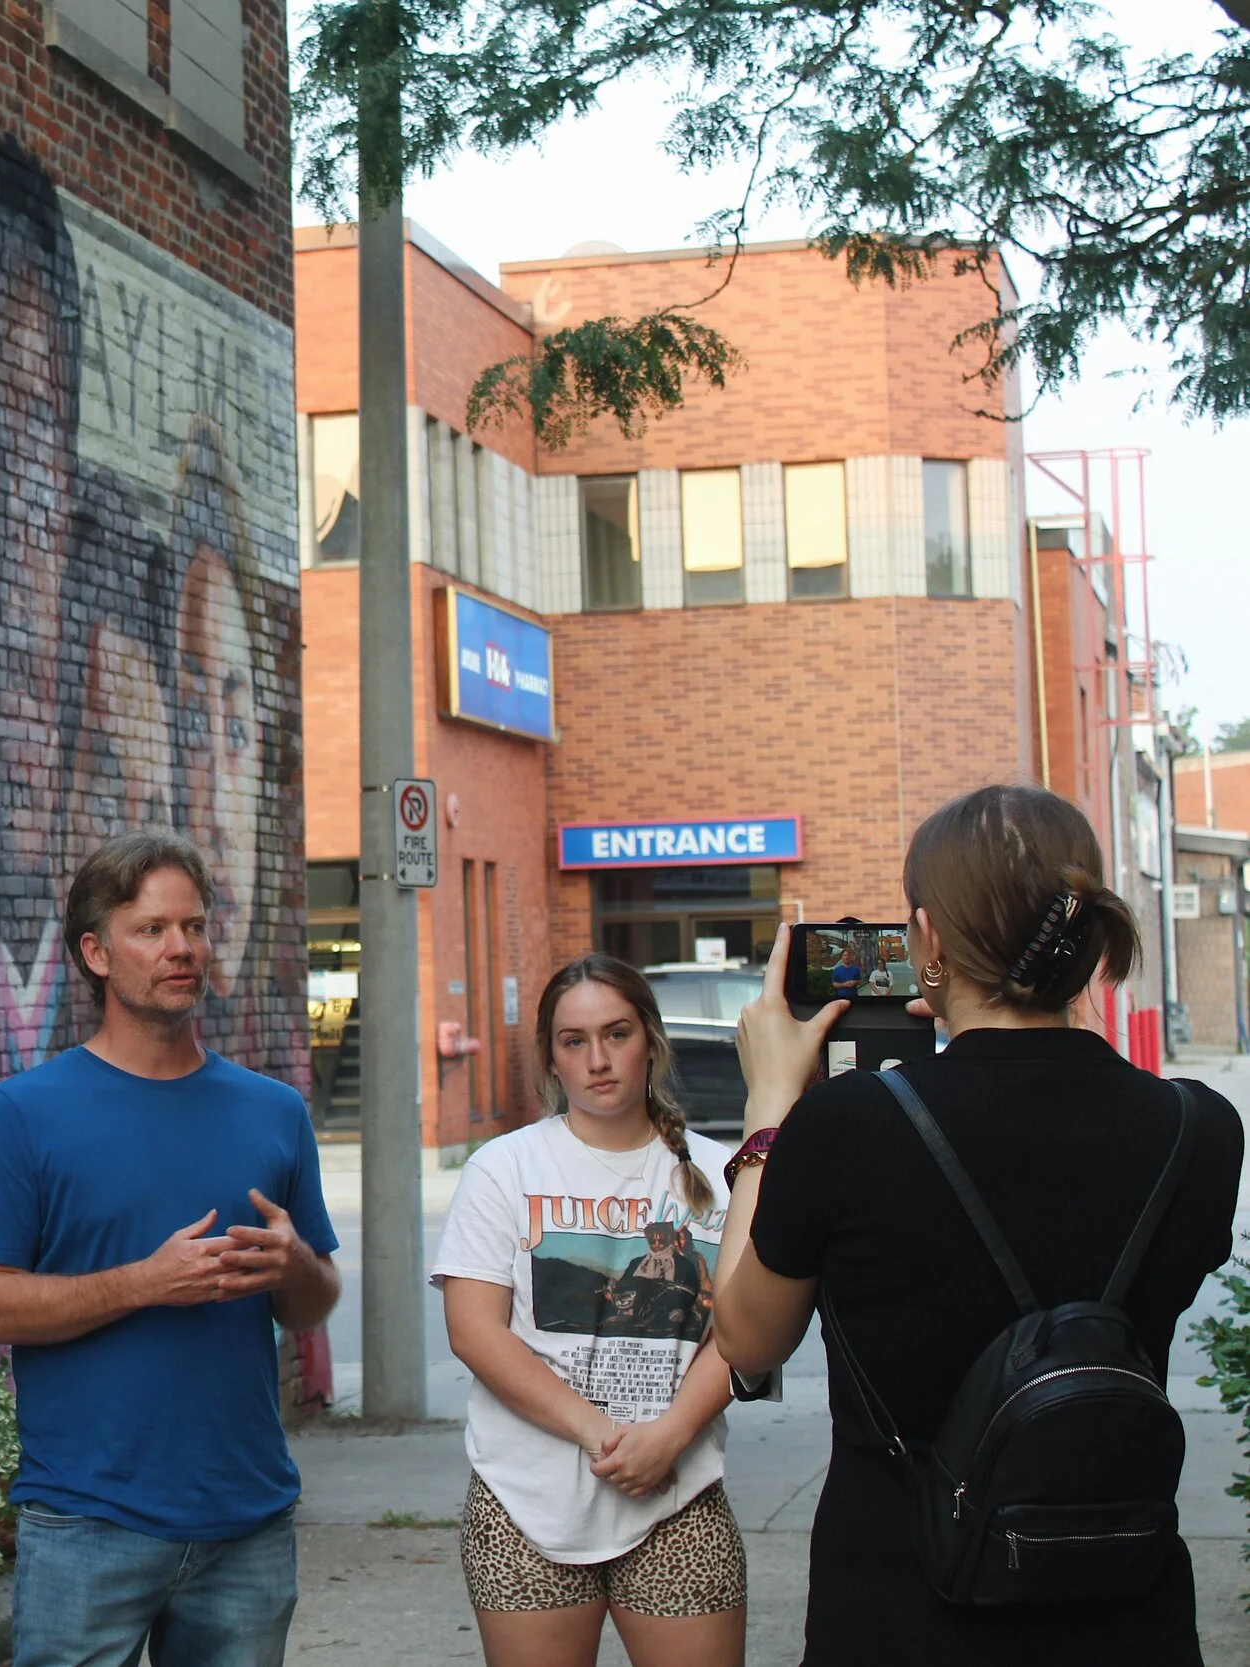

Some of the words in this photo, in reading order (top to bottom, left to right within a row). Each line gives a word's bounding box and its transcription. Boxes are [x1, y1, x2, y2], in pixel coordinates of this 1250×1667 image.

[404, 836, 427, 850] FIRE
[592, 824, 766, 859] ENTRANCE
[398, 851, 434, 866] ROUTE
[520, 1193, 653, 1252] JUICE
